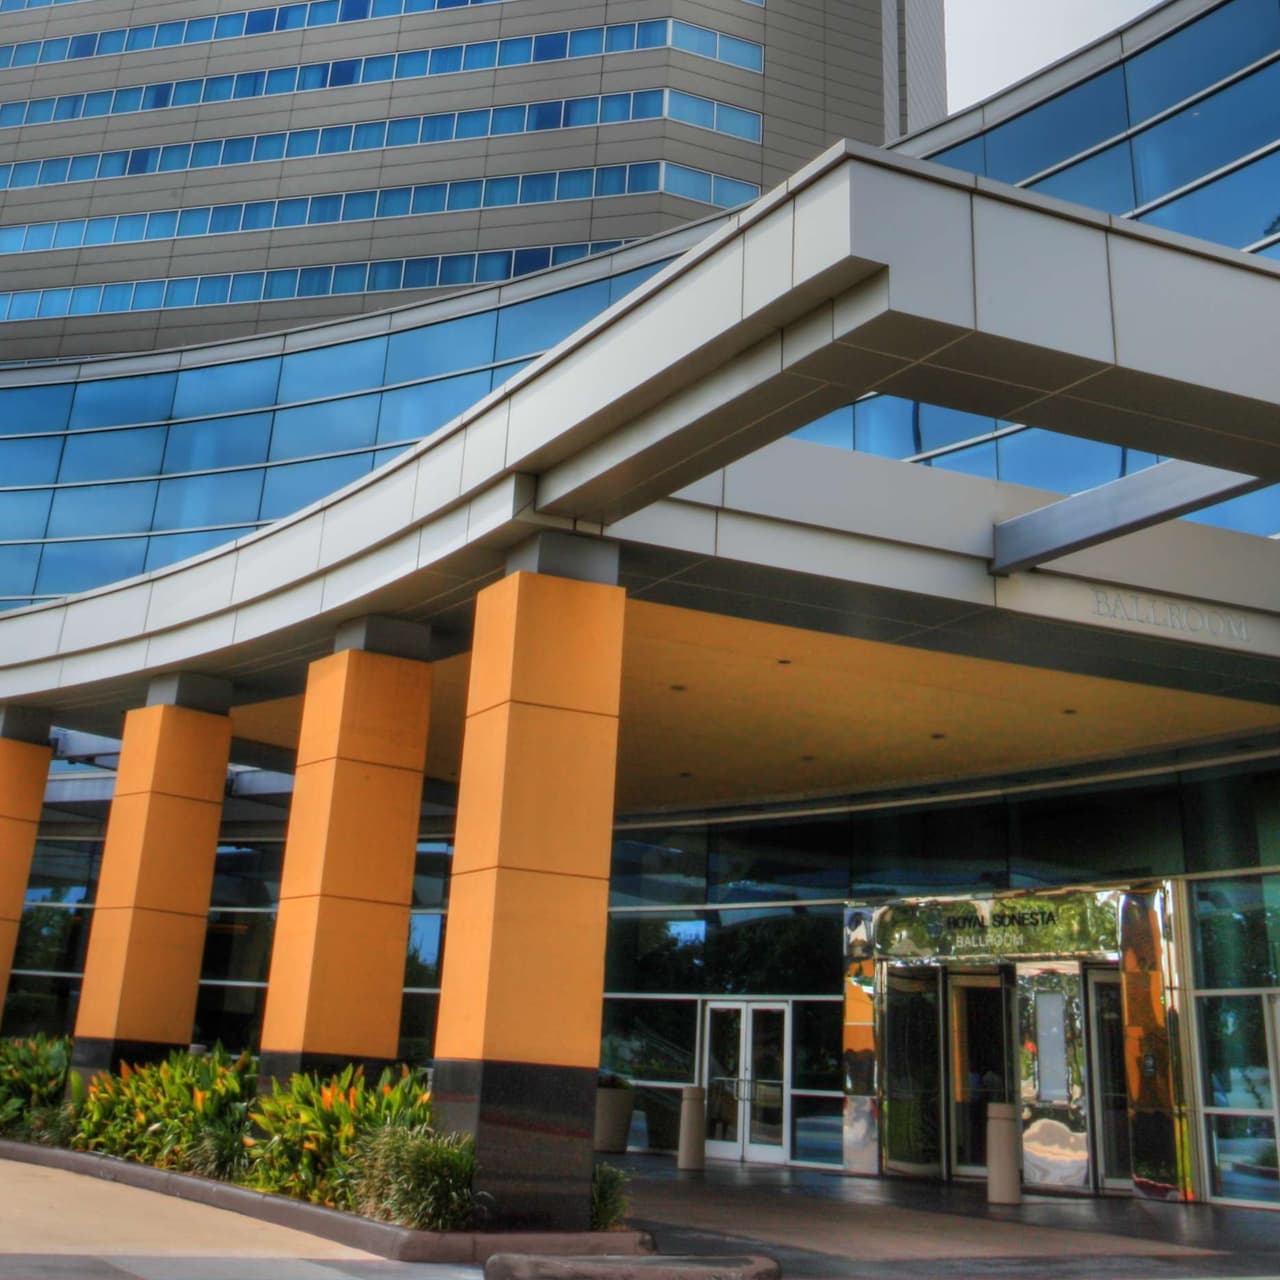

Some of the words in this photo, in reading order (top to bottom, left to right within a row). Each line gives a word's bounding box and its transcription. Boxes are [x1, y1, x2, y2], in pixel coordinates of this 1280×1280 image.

[1092, 589, 1251, 642] BALLROOM
[946, 913, 987, 930] ROYAL
[991, 911, 1057, 928] SONESTA
[955, 934, 1024, 948] BALLROOM
